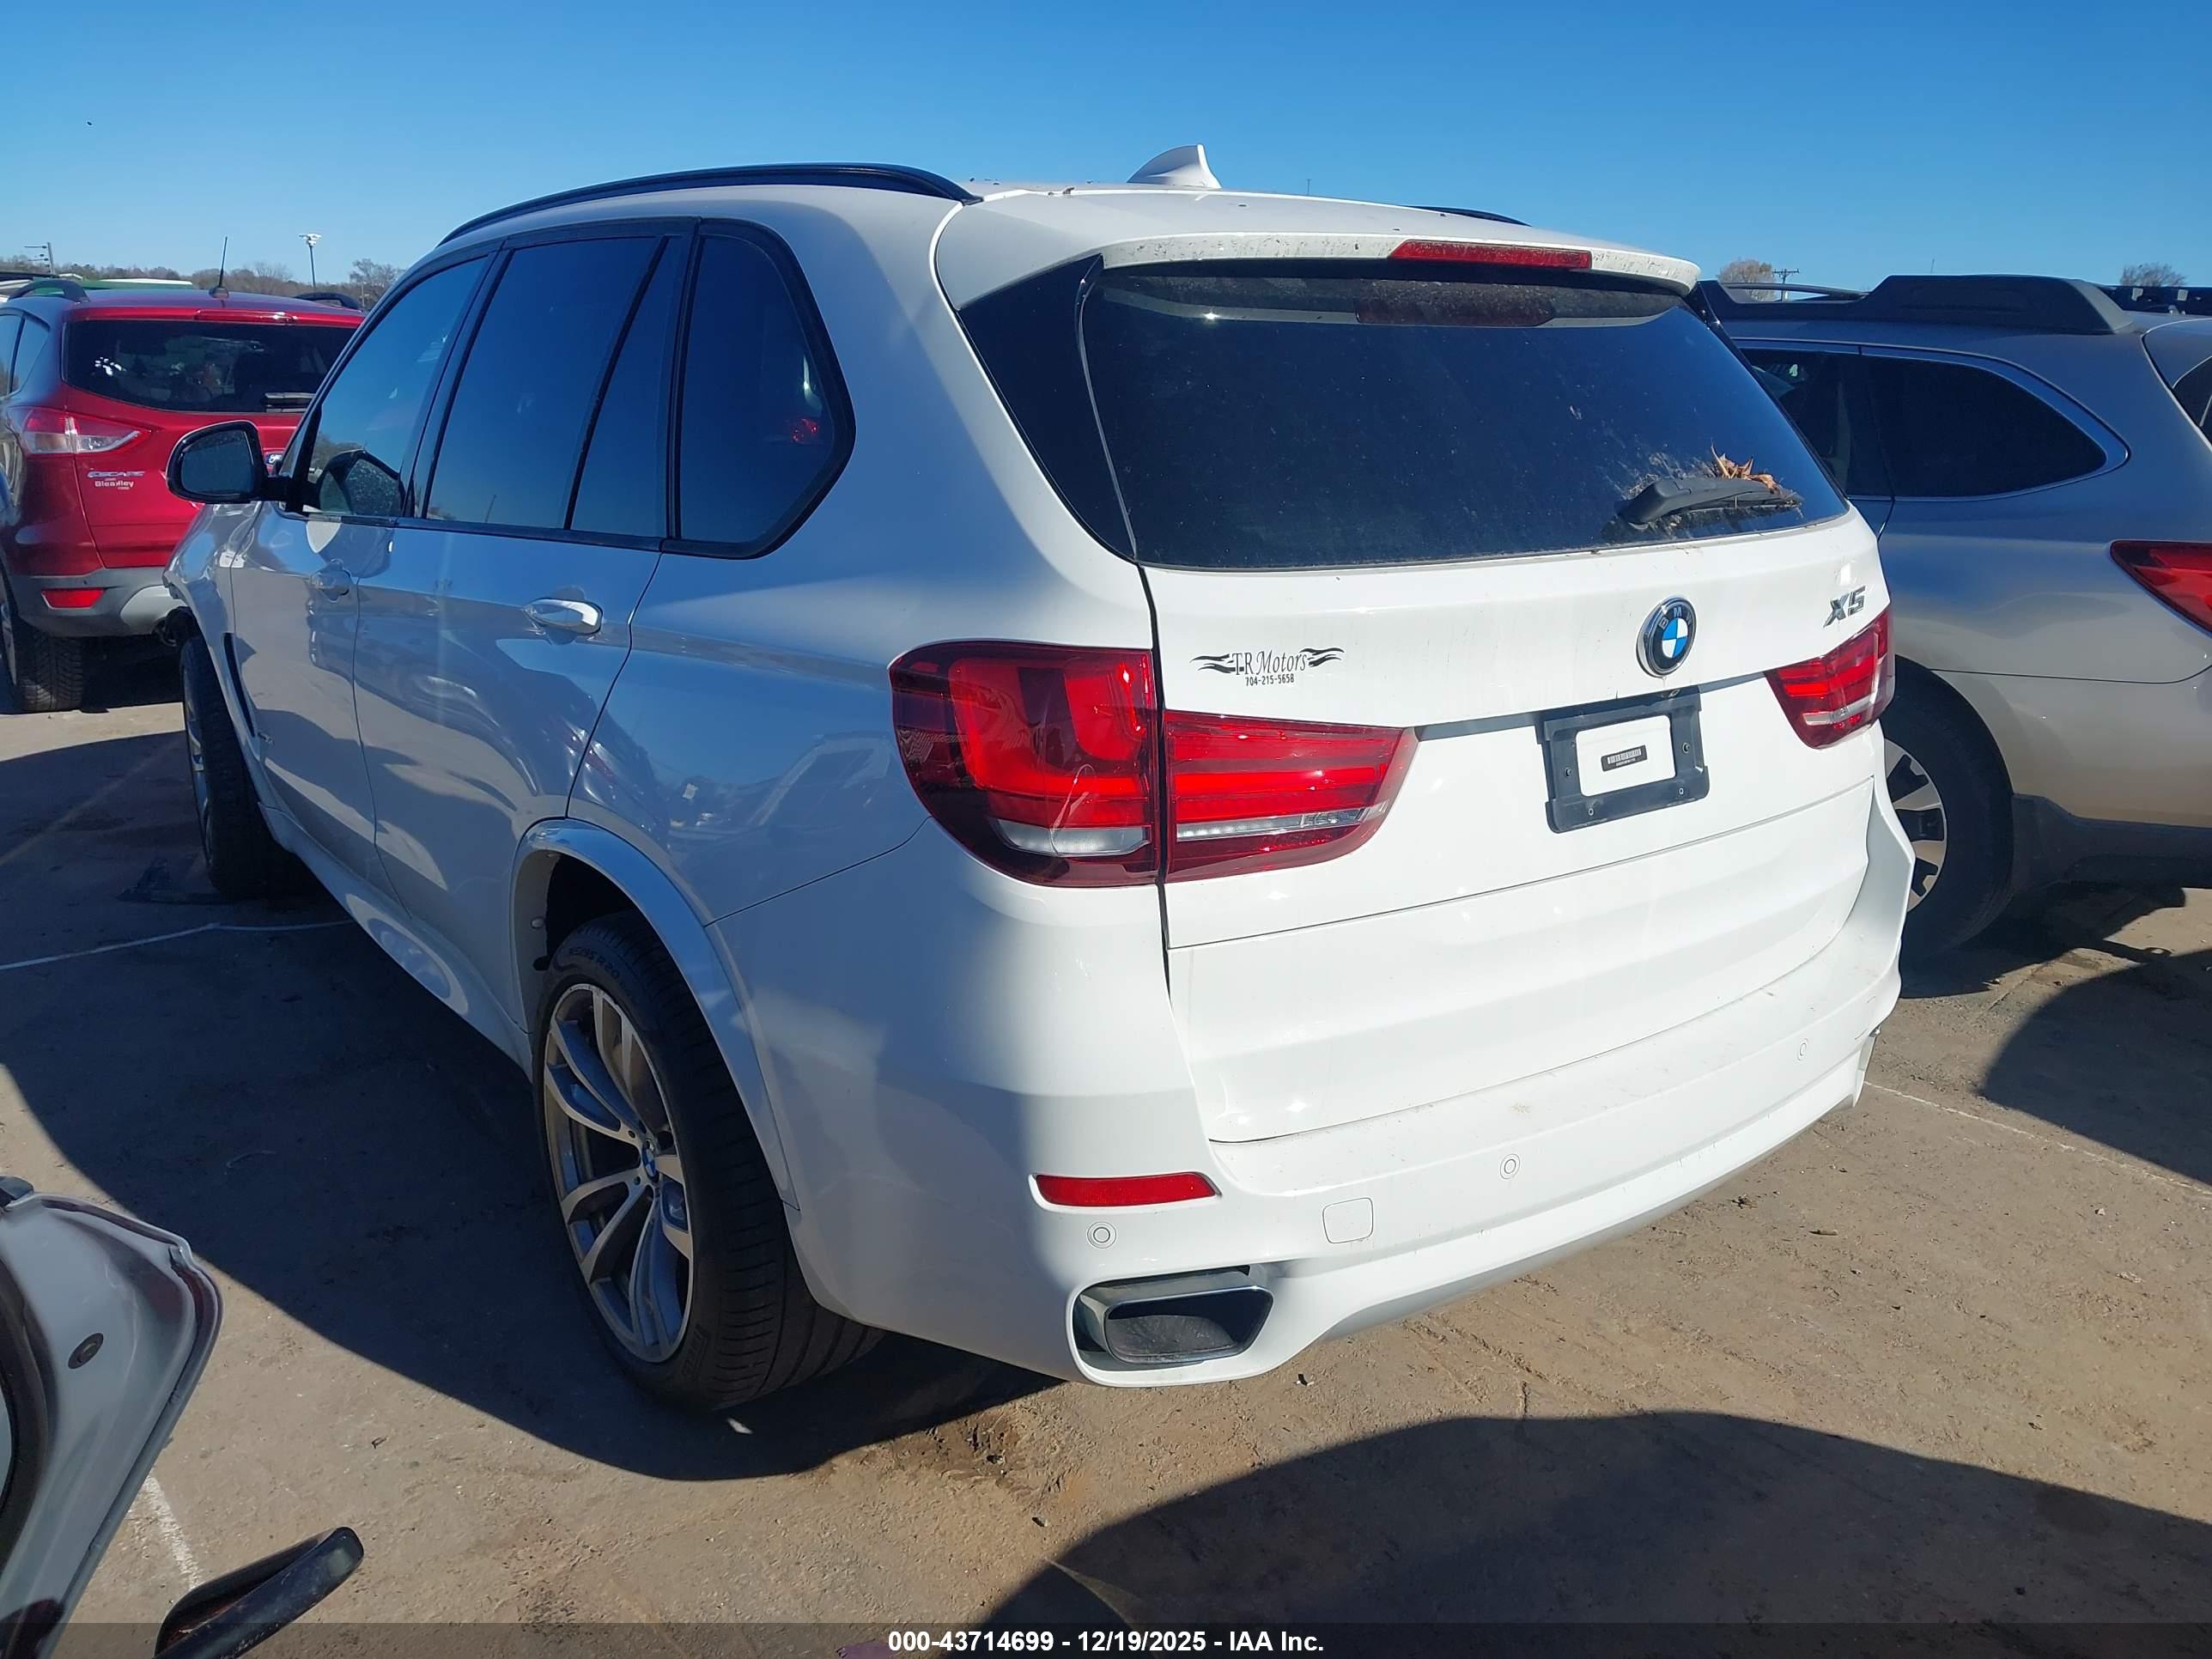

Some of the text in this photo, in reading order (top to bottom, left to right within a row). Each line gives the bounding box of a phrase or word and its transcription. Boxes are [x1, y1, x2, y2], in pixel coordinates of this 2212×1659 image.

[1822, 585, 1867, 629] X5
[1255, 649, 1308, 676] Motors
[1245, 673, 1295, 687] 704-215-5658
